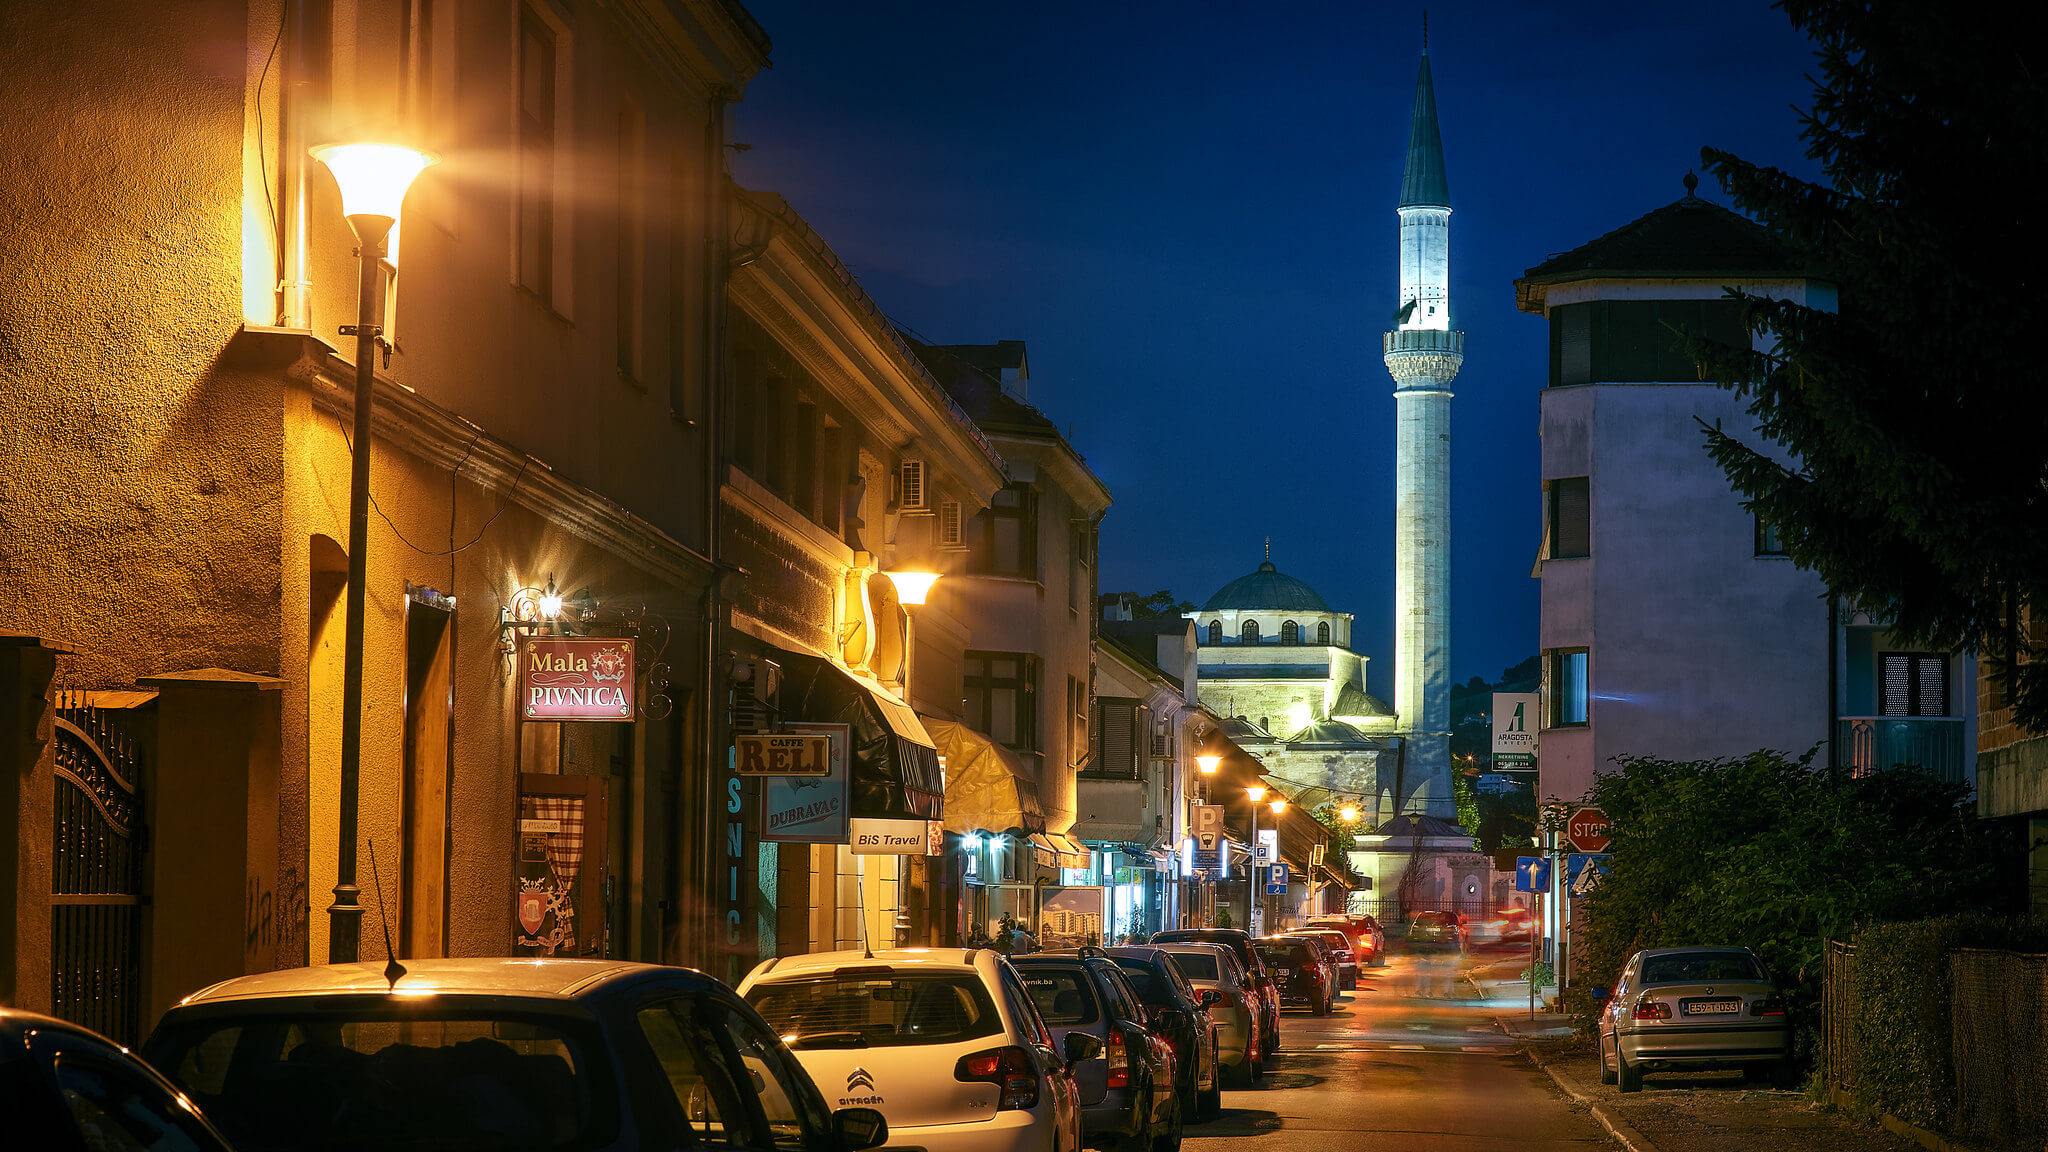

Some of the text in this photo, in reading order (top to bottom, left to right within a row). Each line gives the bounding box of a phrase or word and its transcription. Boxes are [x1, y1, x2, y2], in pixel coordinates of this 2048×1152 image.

[529, 652, 588, 672] Mala
[529, 687, 628, 706] PIVNICA
[770, 739, 804, 747] CAFFE
[740, 740, 825, 772] RELI
[769, 797, 839, 828] DUBRAVAC
[858, 834, 920, 845] BiS Travel
[1574, 822, 1607, 838] STOP
